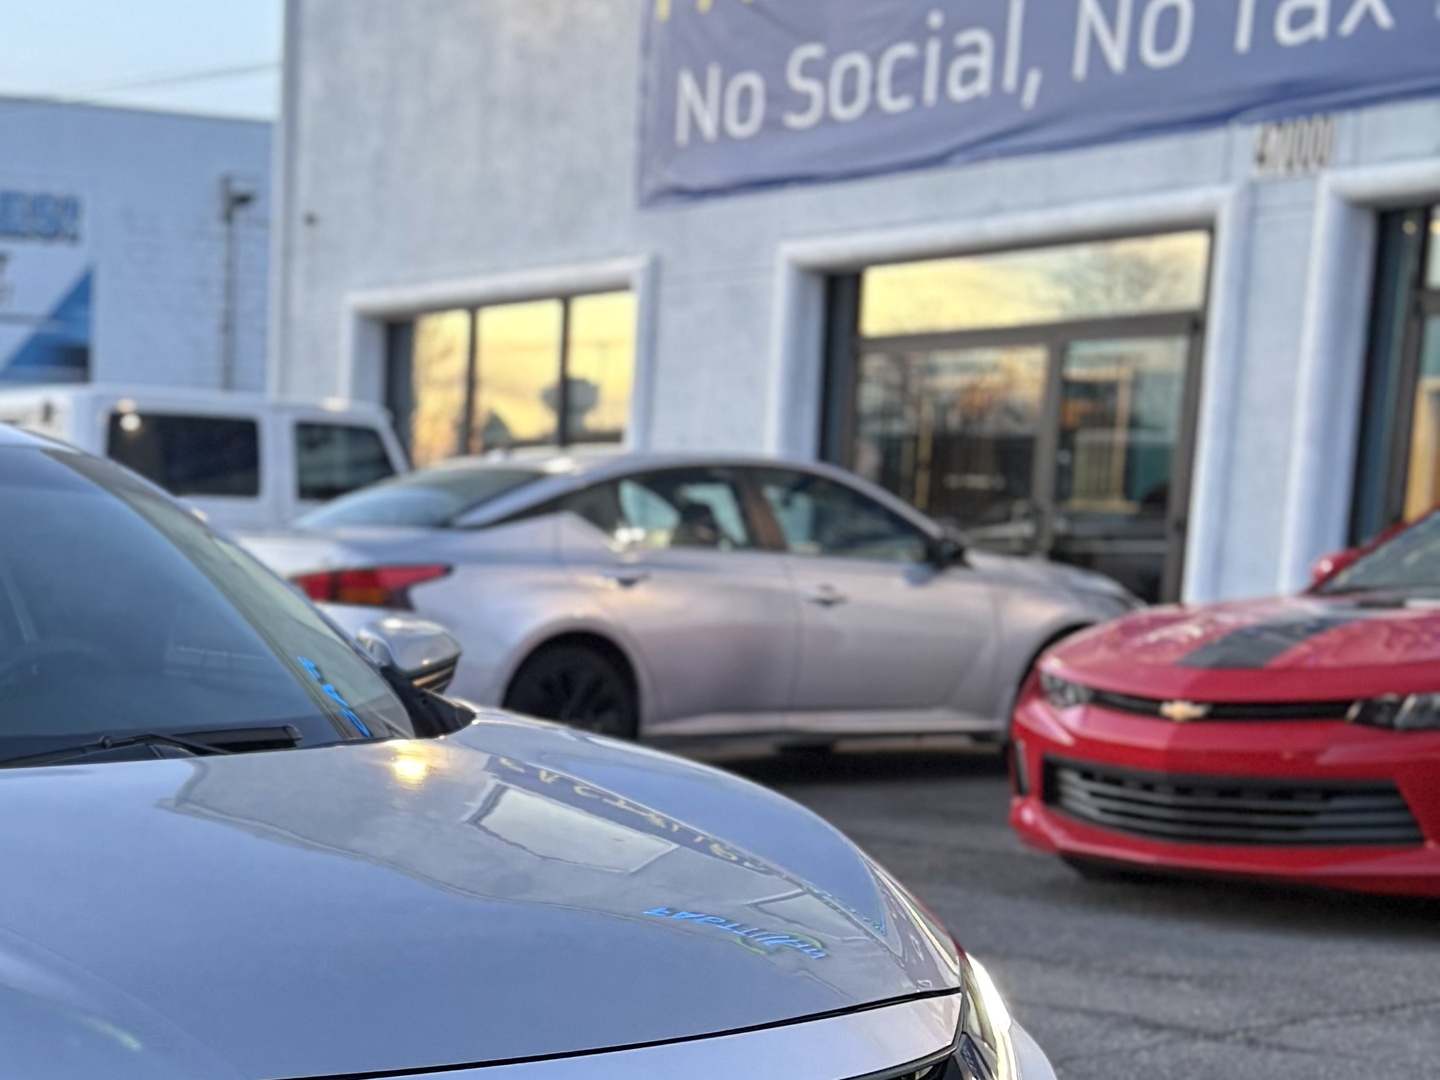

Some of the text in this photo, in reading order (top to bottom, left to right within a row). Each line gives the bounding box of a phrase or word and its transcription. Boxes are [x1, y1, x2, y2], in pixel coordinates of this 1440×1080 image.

[673, 60, 766, 147] No
[782, 0, 1043, 130] Social,
[1071, 0, 1195, 82] No
